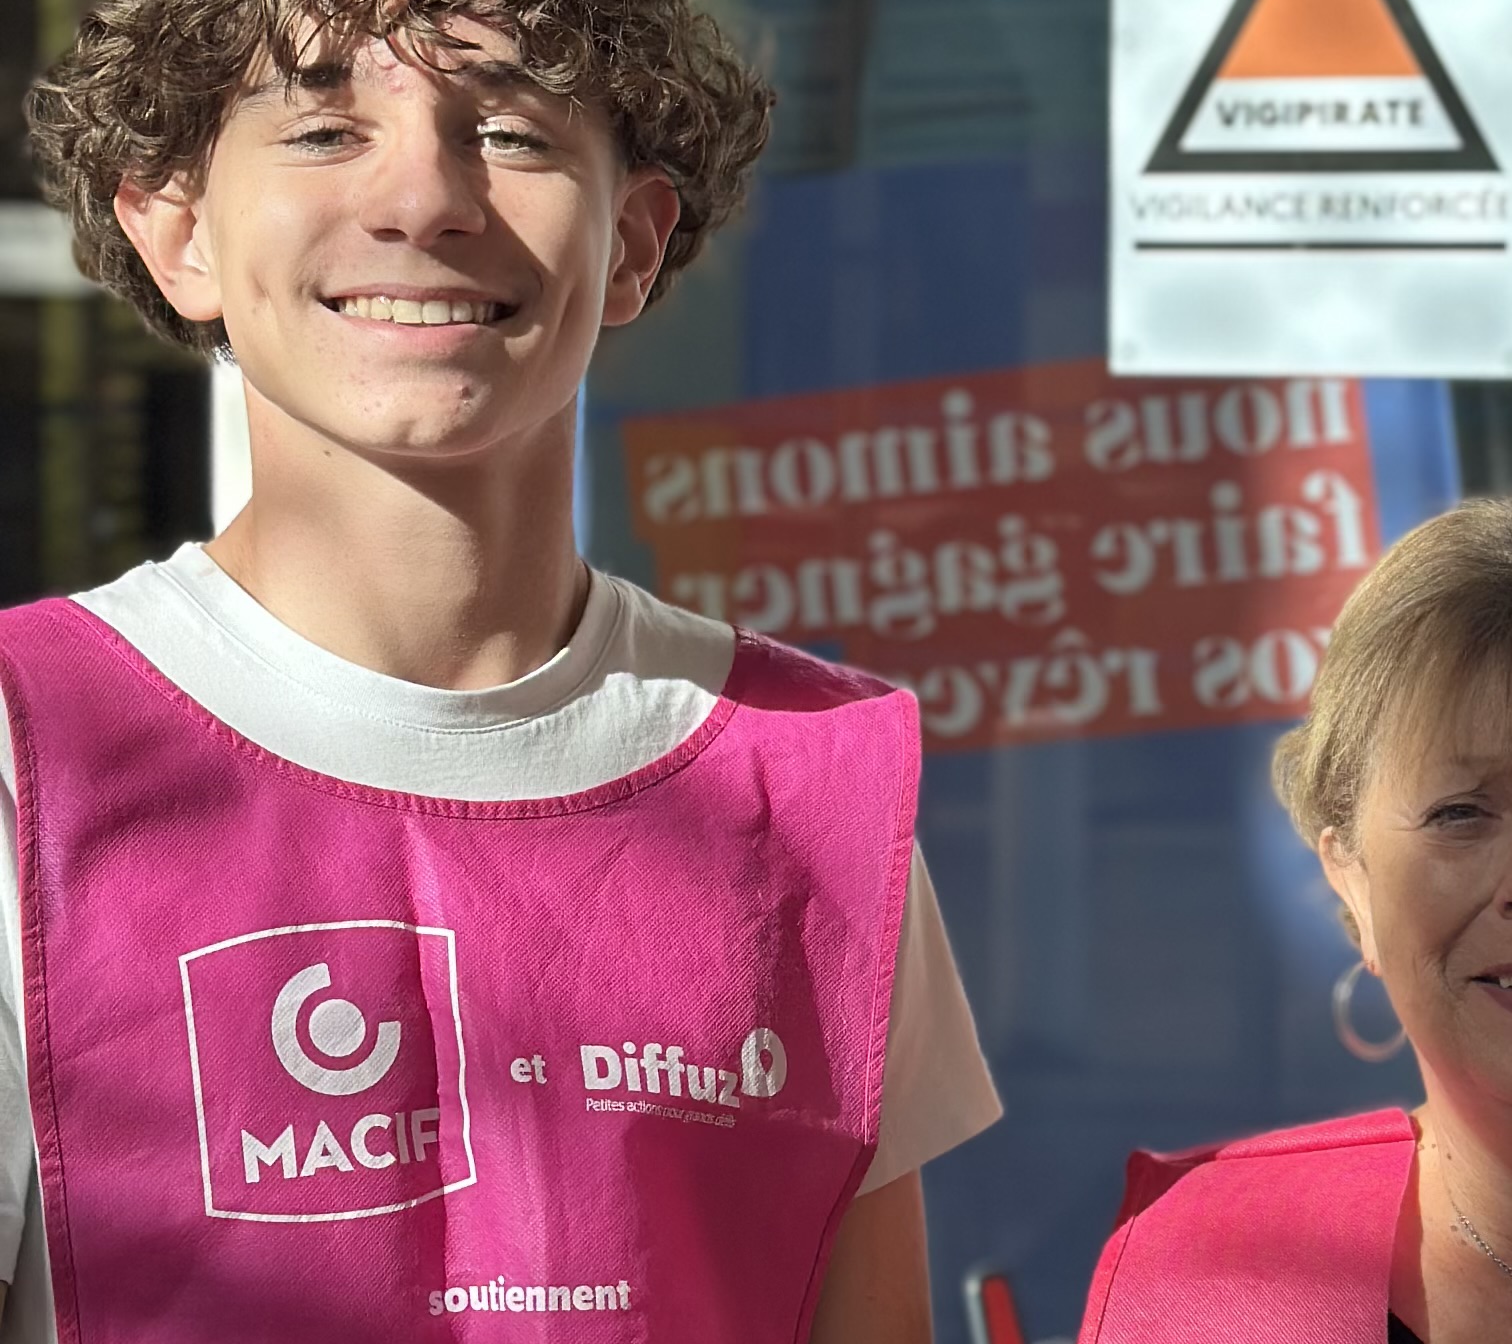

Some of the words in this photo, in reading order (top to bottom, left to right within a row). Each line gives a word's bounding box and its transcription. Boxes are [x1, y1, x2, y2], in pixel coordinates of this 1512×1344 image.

[1216, 98, 1425, 129] VIGIPIRATE
[1129, 192, 1309, 223] VIGILANCE
[240, 1107, 440, 1184] MACIF
[510, 1053, 547, 1085] et
[580, 1041, 742, 1109] Diffuz
[586, 1098, 625, 1112] Petites
[429, 1275, 632, 1316] soutiennent
